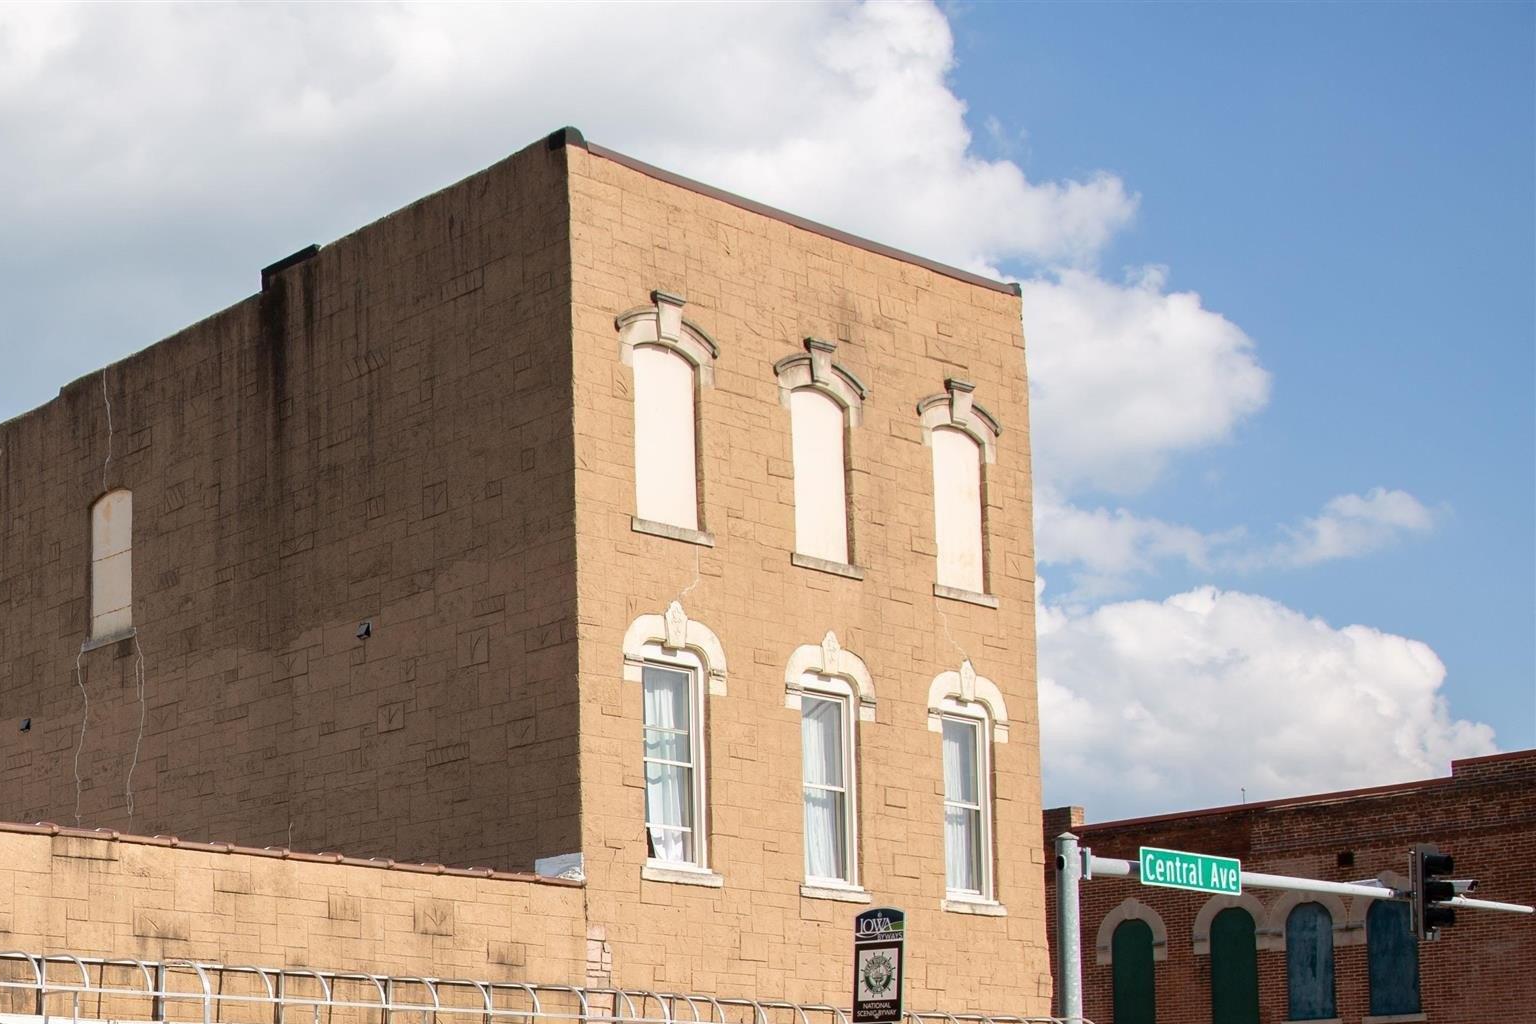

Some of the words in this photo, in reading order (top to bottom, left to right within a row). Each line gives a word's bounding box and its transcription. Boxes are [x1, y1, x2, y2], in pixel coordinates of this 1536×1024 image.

[1145, 854, 1203, 886] Central
[1210, 862, 1237, 890] Ave
[860, 917, 893, 934] IOWA
[877, 933, 902, 941] BYWAYS
